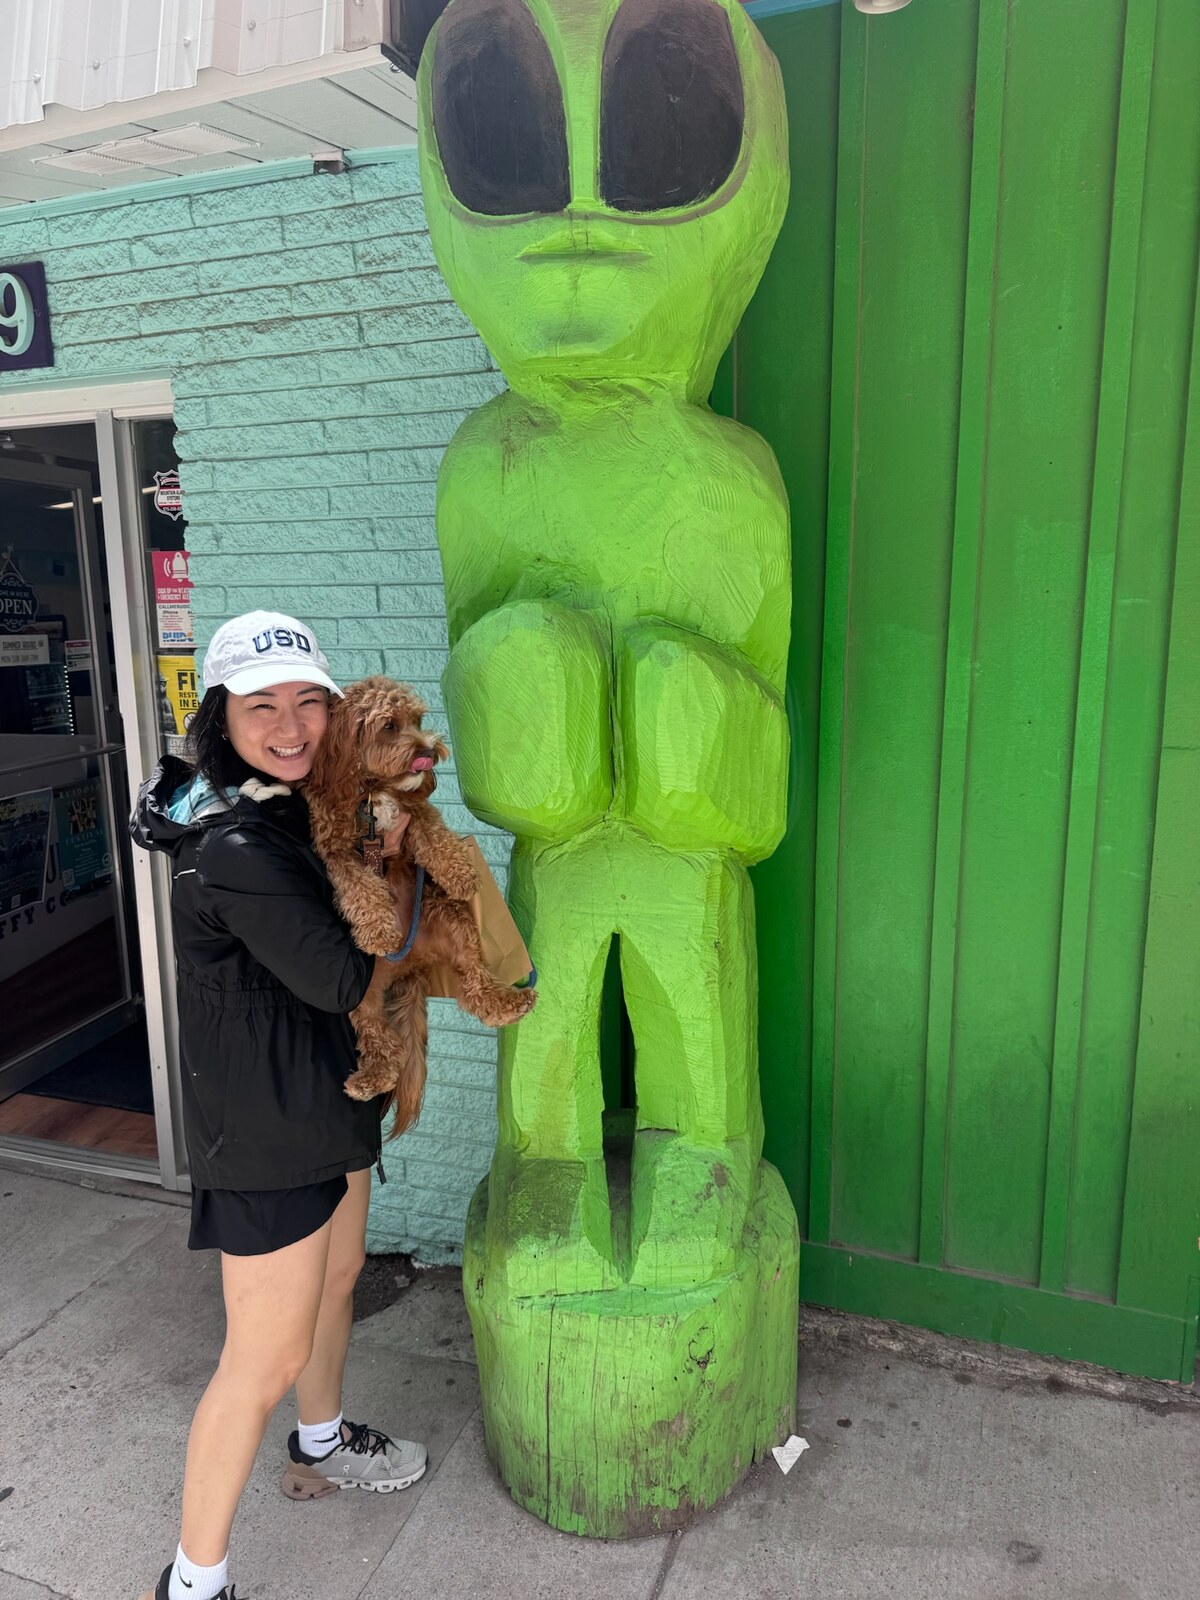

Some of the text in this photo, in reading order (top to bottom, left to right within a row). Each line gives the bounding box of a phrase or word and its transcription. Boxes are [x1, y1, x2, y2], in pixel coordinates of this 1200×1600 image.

[0, 272, 35, 355] 9
[252, 629, 311, 653] USD
[177, 672, 197, 691] FI
[180, 699, 189, 707] IN
